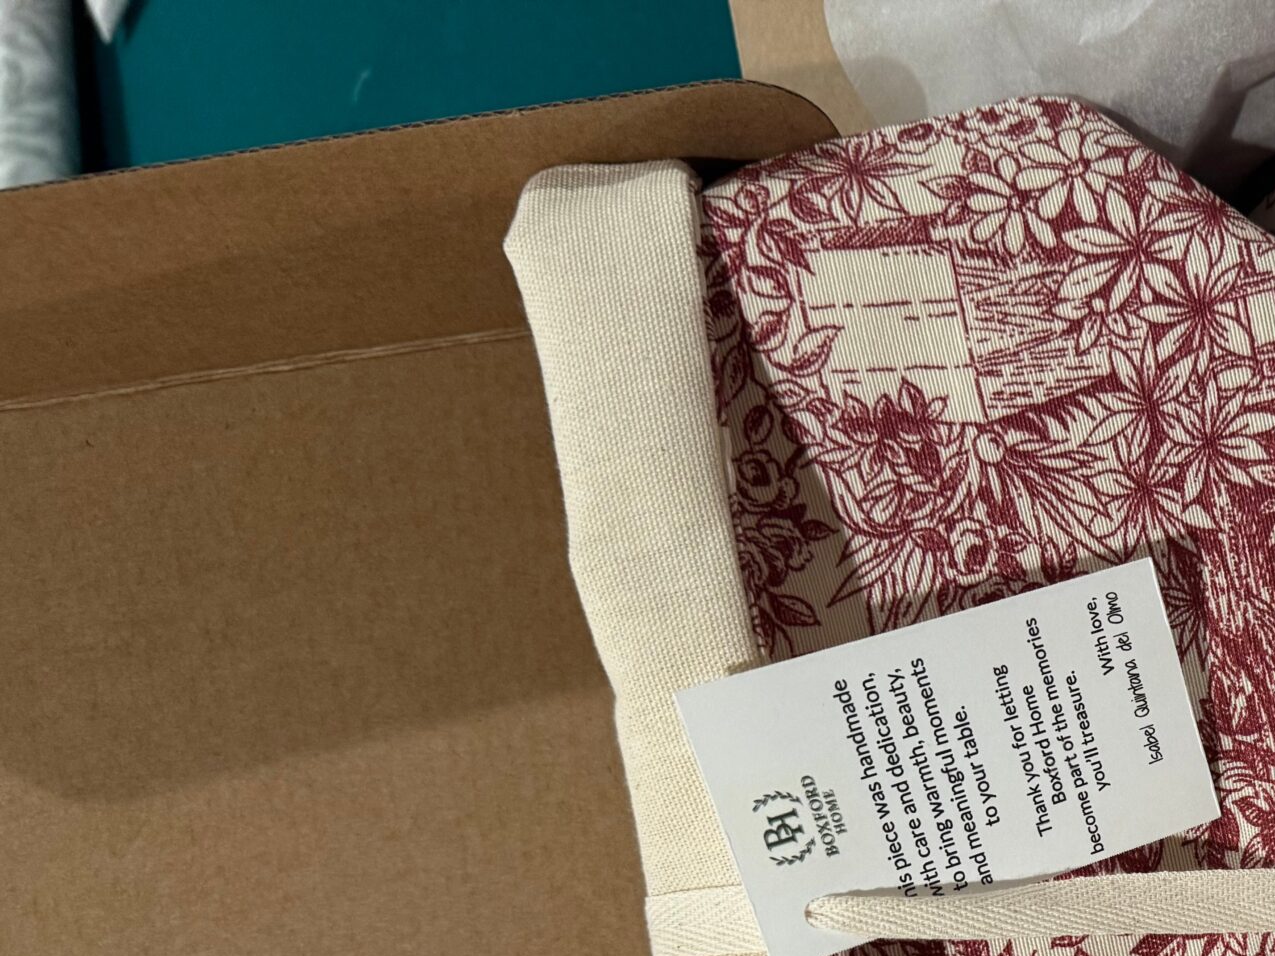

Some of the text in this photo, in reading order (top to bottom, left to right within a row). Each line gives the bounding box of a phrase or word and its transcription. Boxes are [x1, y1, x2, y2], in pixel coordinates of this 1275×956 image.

[1085, 596, 1115, 676] With love,
[1104, 590, 1164, 765] Isabel Quintana del Olmo
[861, 671, 904, 778] dedication,
[952, 704, 1001, 827] to your table.
[991, 663, 1053, 838] Thank you for letting
[1021, 683, 1067, 805] Boxford Home
[1024, 616, 1105, 855] become part of the memories
[1064, 669, 1095, 746] treasure.
[799, 774, 840, 857] BOXFORD
[821, 788, 848, 835] HOME
[831, 678, 918, 897] his piece was handmade
[886, 667, 968, 891] to bring warmth, beauty,
[889, 779, 917, 815] and
[909, 656, 993, 885] and meaningful moments
[907, 816, 931, 858] care
